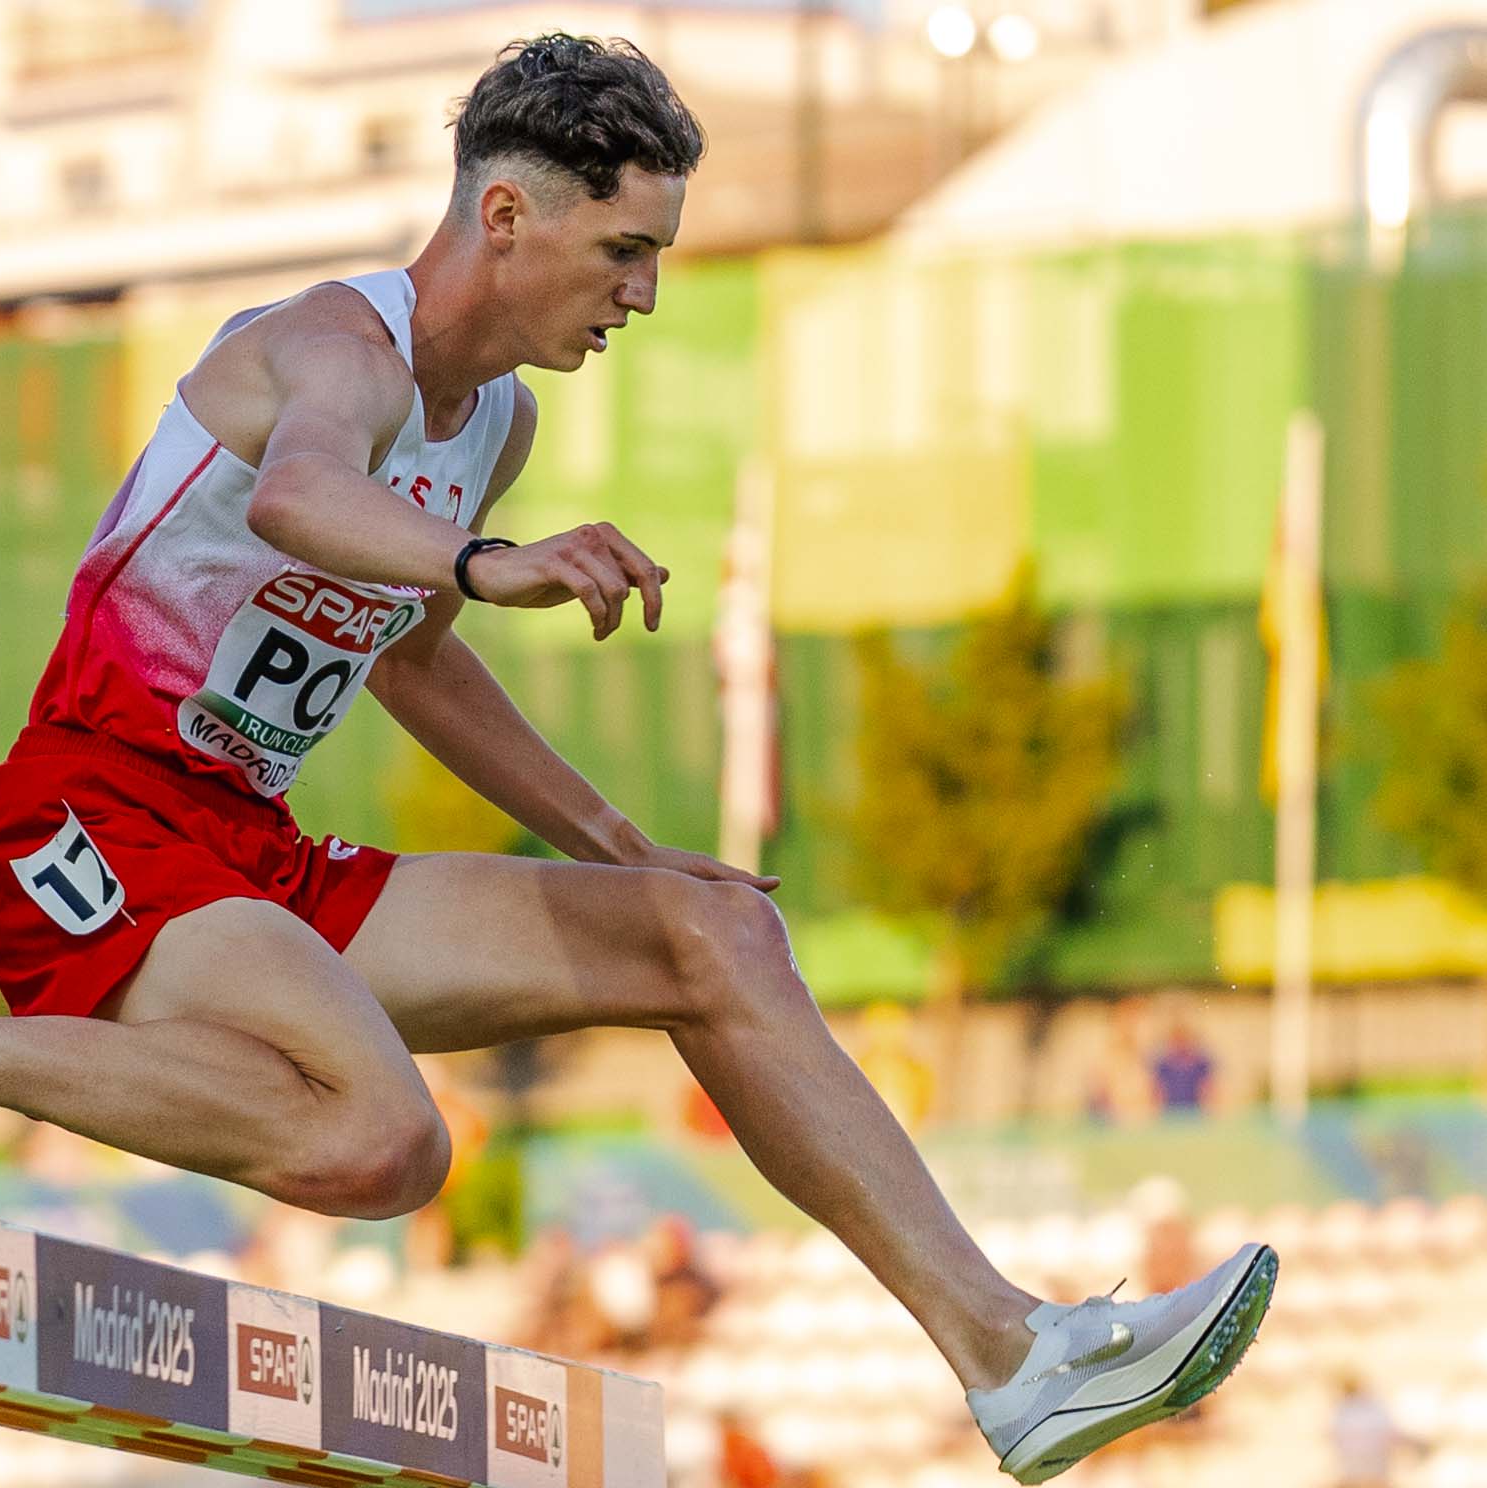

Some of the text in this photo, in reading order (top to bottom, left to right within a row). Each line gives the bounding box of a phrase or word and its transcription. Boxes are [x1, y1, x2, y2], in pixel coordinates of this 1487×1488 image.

[190, 713, 288, 788] MADRID
[74, 1281, 144, 1376] Madrid
[146, 1298, 195, 1387] 2025
[249, 1337, 297, 1390] SPAR
[352, 1345, 414, 1432] Madrid
[414, 1359, 459, 1442] 2025
[506, 1399, 547, 1450] SPAR
